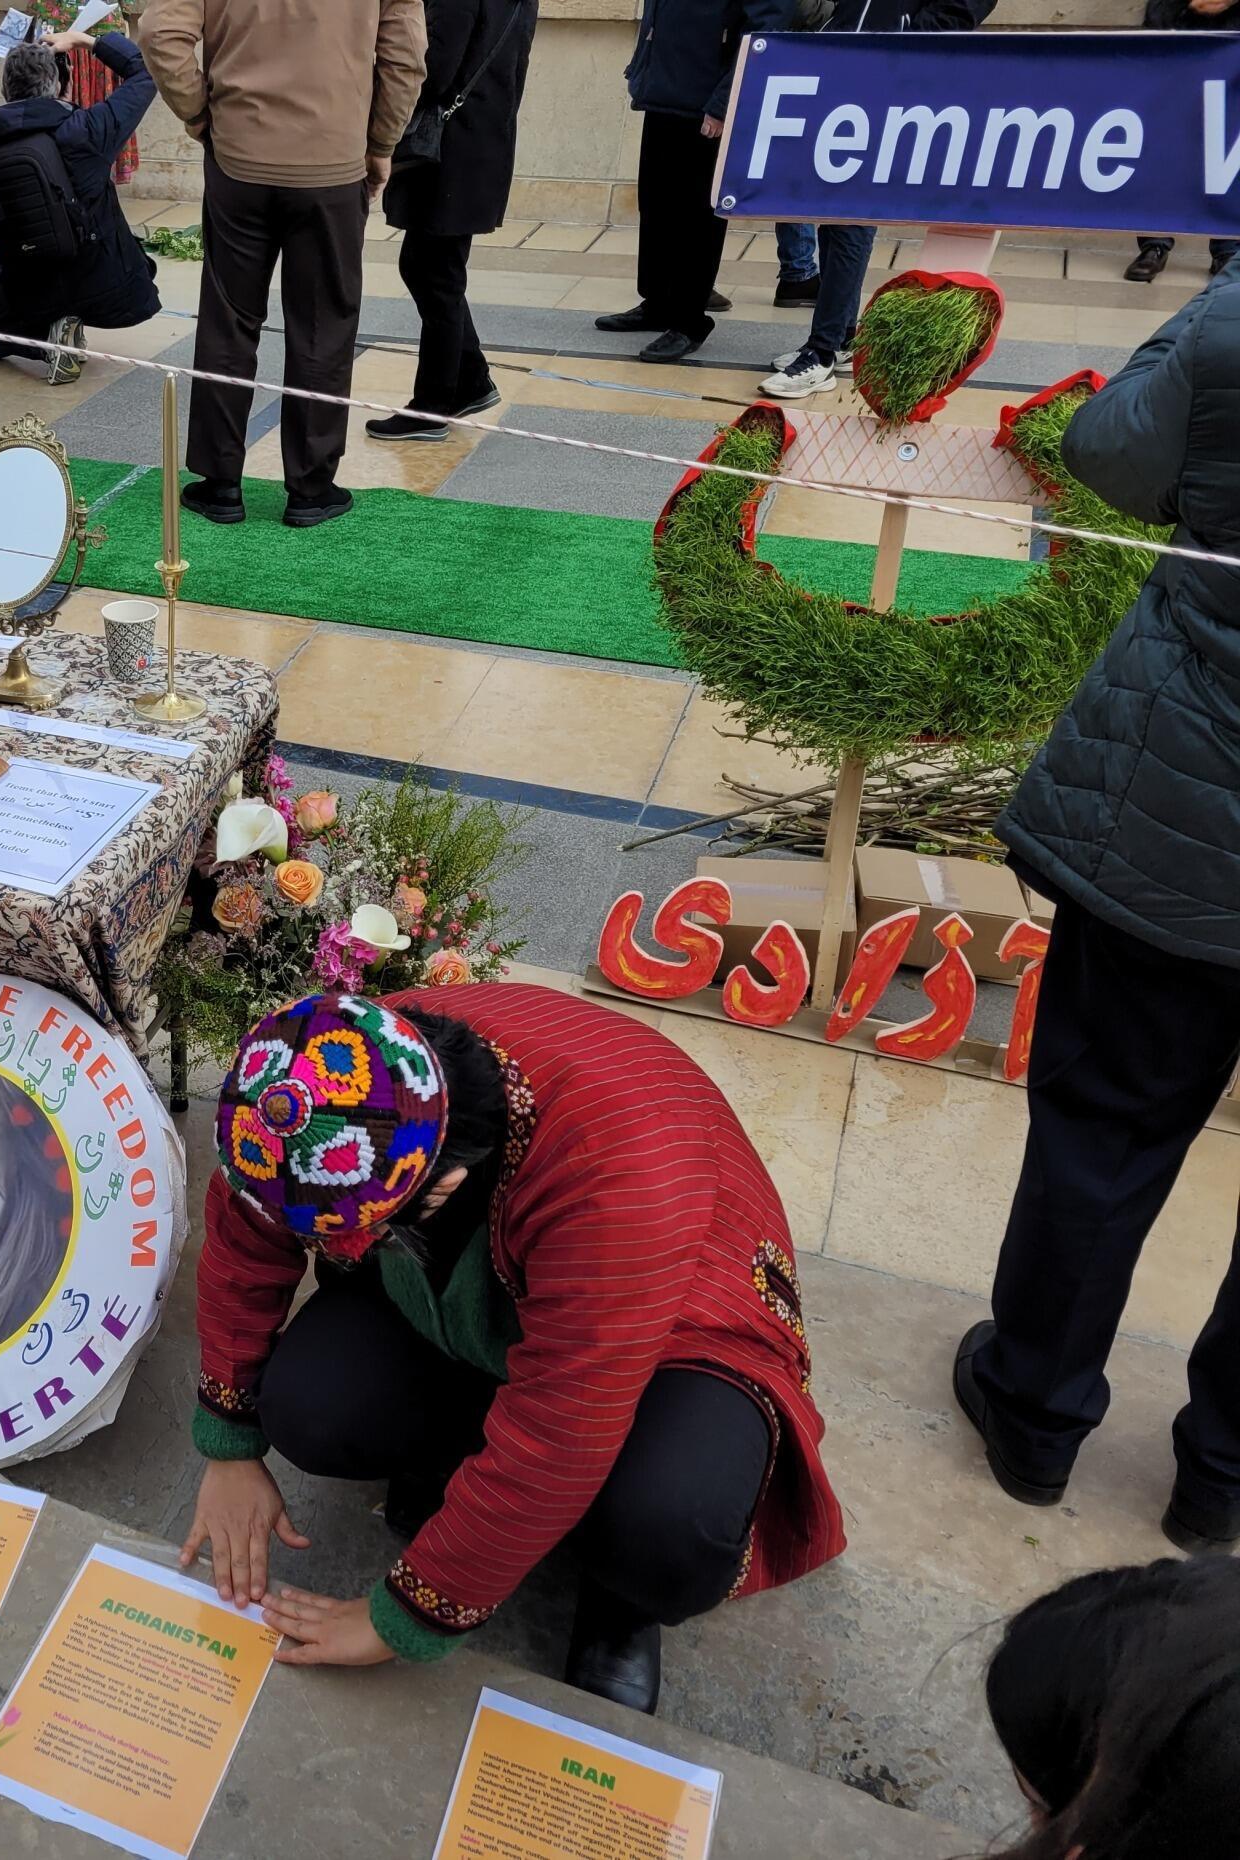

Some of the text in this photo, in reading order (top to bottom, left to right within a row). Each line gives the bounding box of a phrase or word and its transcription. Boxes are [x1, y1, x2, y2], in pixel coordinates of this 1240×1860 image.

[747, 74, 1144, 193] Femme
[4, 782, 33, 792] Items
[35, 788, 58, 797] that
[89, 800, 115, 809] start
[53, 806, 71, 814] /
[12, 814, 72, 830] nonetheless
[13, 830, 70, 847] invariably
[38, 1007, 158, 1268] FREEDOM
[100, 1598, 236, 1659] AFGHANISTAN
[480, 1760, 500, 1770] called
[549, 1785, 570, 1796] which
[572, 1794, 606, 1811] translates
[483, 1751, 509, 1765] Iranians
[510, 1762, 536, 1775] prepare
[538, 1771, 548, 1779] for
[550, 1776, 561, 1784] the
[591, 1793, 607, 1802] with
[560, 1757, 615, 1790] IRAN
[516, 1781, 527, 1789] the
[528, 1785, 540, 1794] last
[592, 1810, 603, 1819] the
[604, 1825, 620, 1835] with
